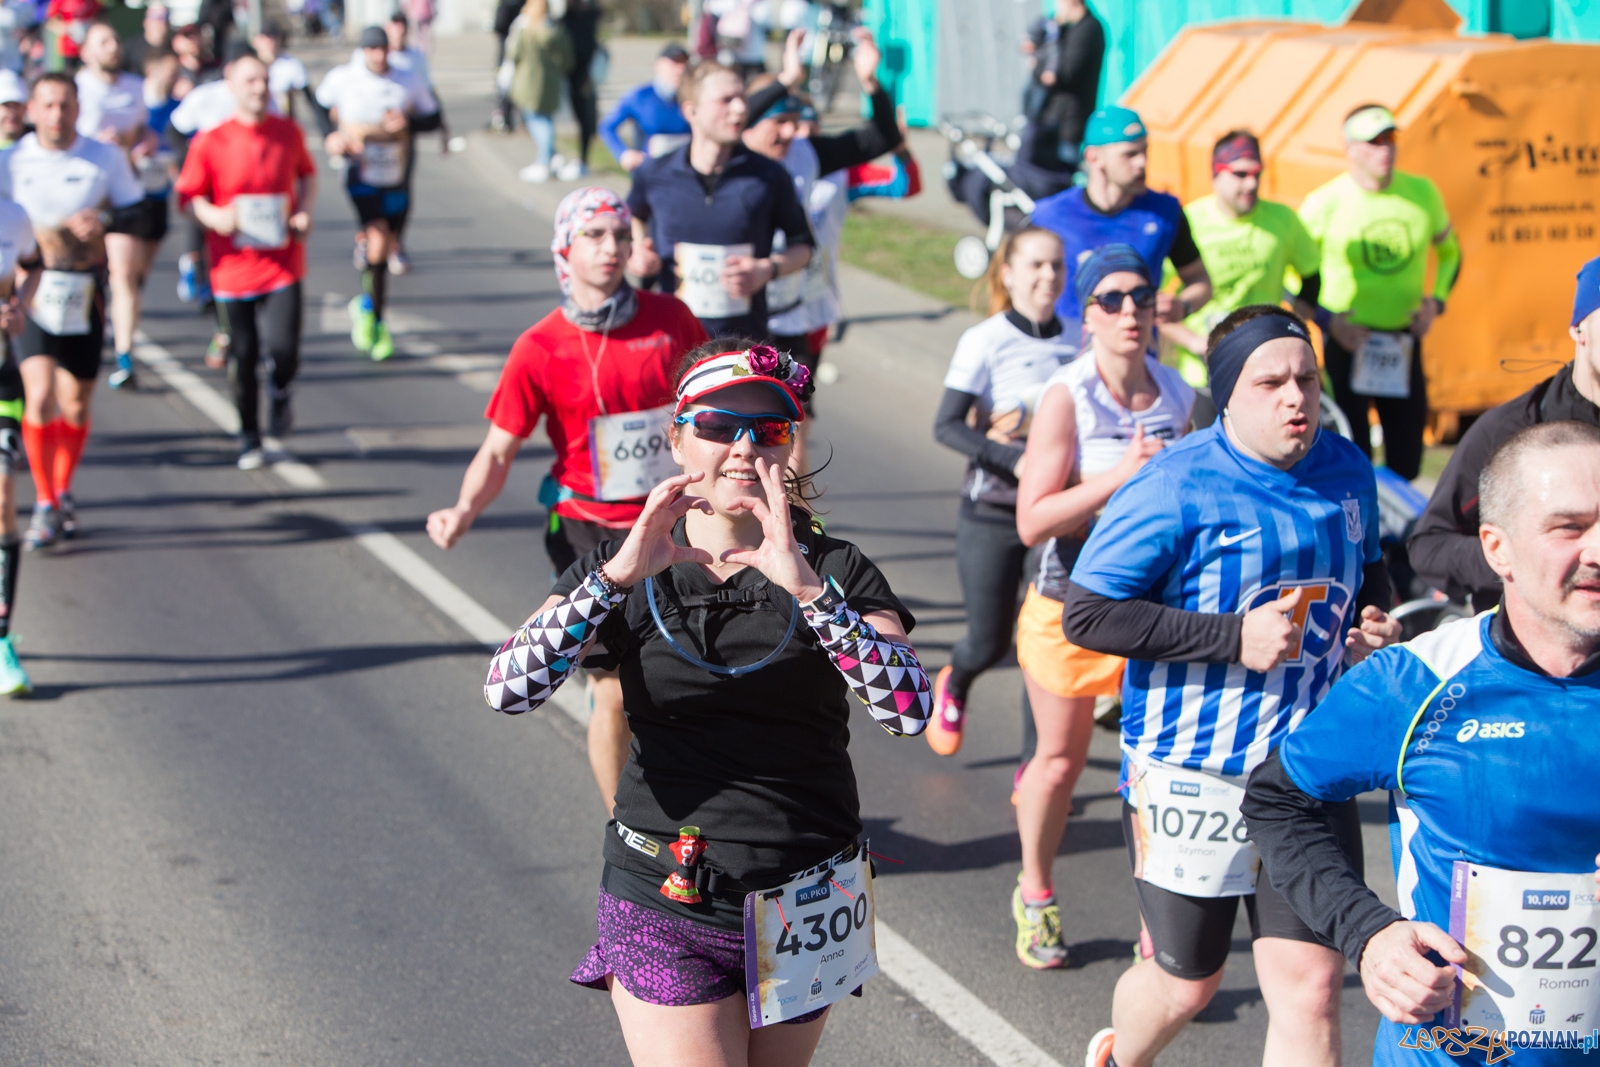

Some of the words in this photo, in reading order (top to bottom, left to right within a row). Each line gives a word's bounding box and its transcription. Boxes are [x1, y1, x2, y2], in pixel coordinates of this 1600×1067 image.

[1148, 804, 1251, 844] 10726
[1178, 845, 1216, 857] Szymon
[799, 893, 810, 901] 10.
[811, 886, 828, 898] PKO
[1527, 895, 1541, 906] 10.
[1543, 895, 1567, 906] PKO
[775, 892, 867, 956] 4300
[1497, 924, 1598, 970] 822
[820, 949, 845, 964] Anna
[1539, 978, 1590, 990] Roman
